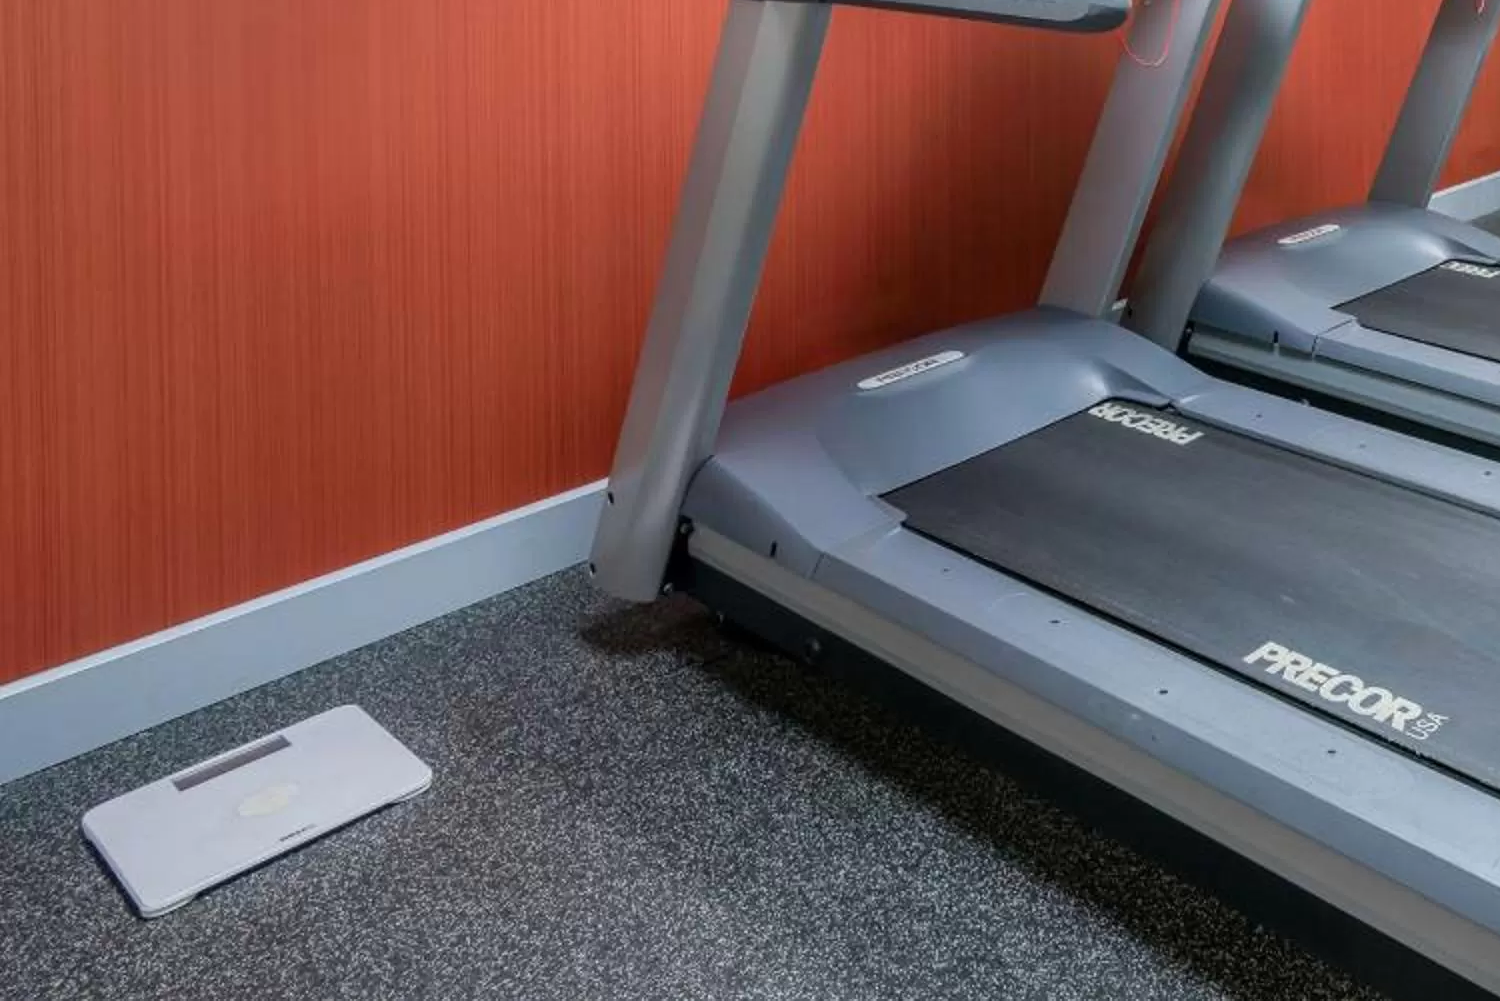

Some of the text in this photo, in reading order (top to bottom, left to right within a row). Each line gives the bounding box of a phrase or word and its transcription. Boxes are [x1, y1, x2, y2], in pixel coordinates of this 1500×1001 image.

[1088, 402, 1205, 446] PRECOR
[1243, 641, 1449, 740] PRECOR USA
